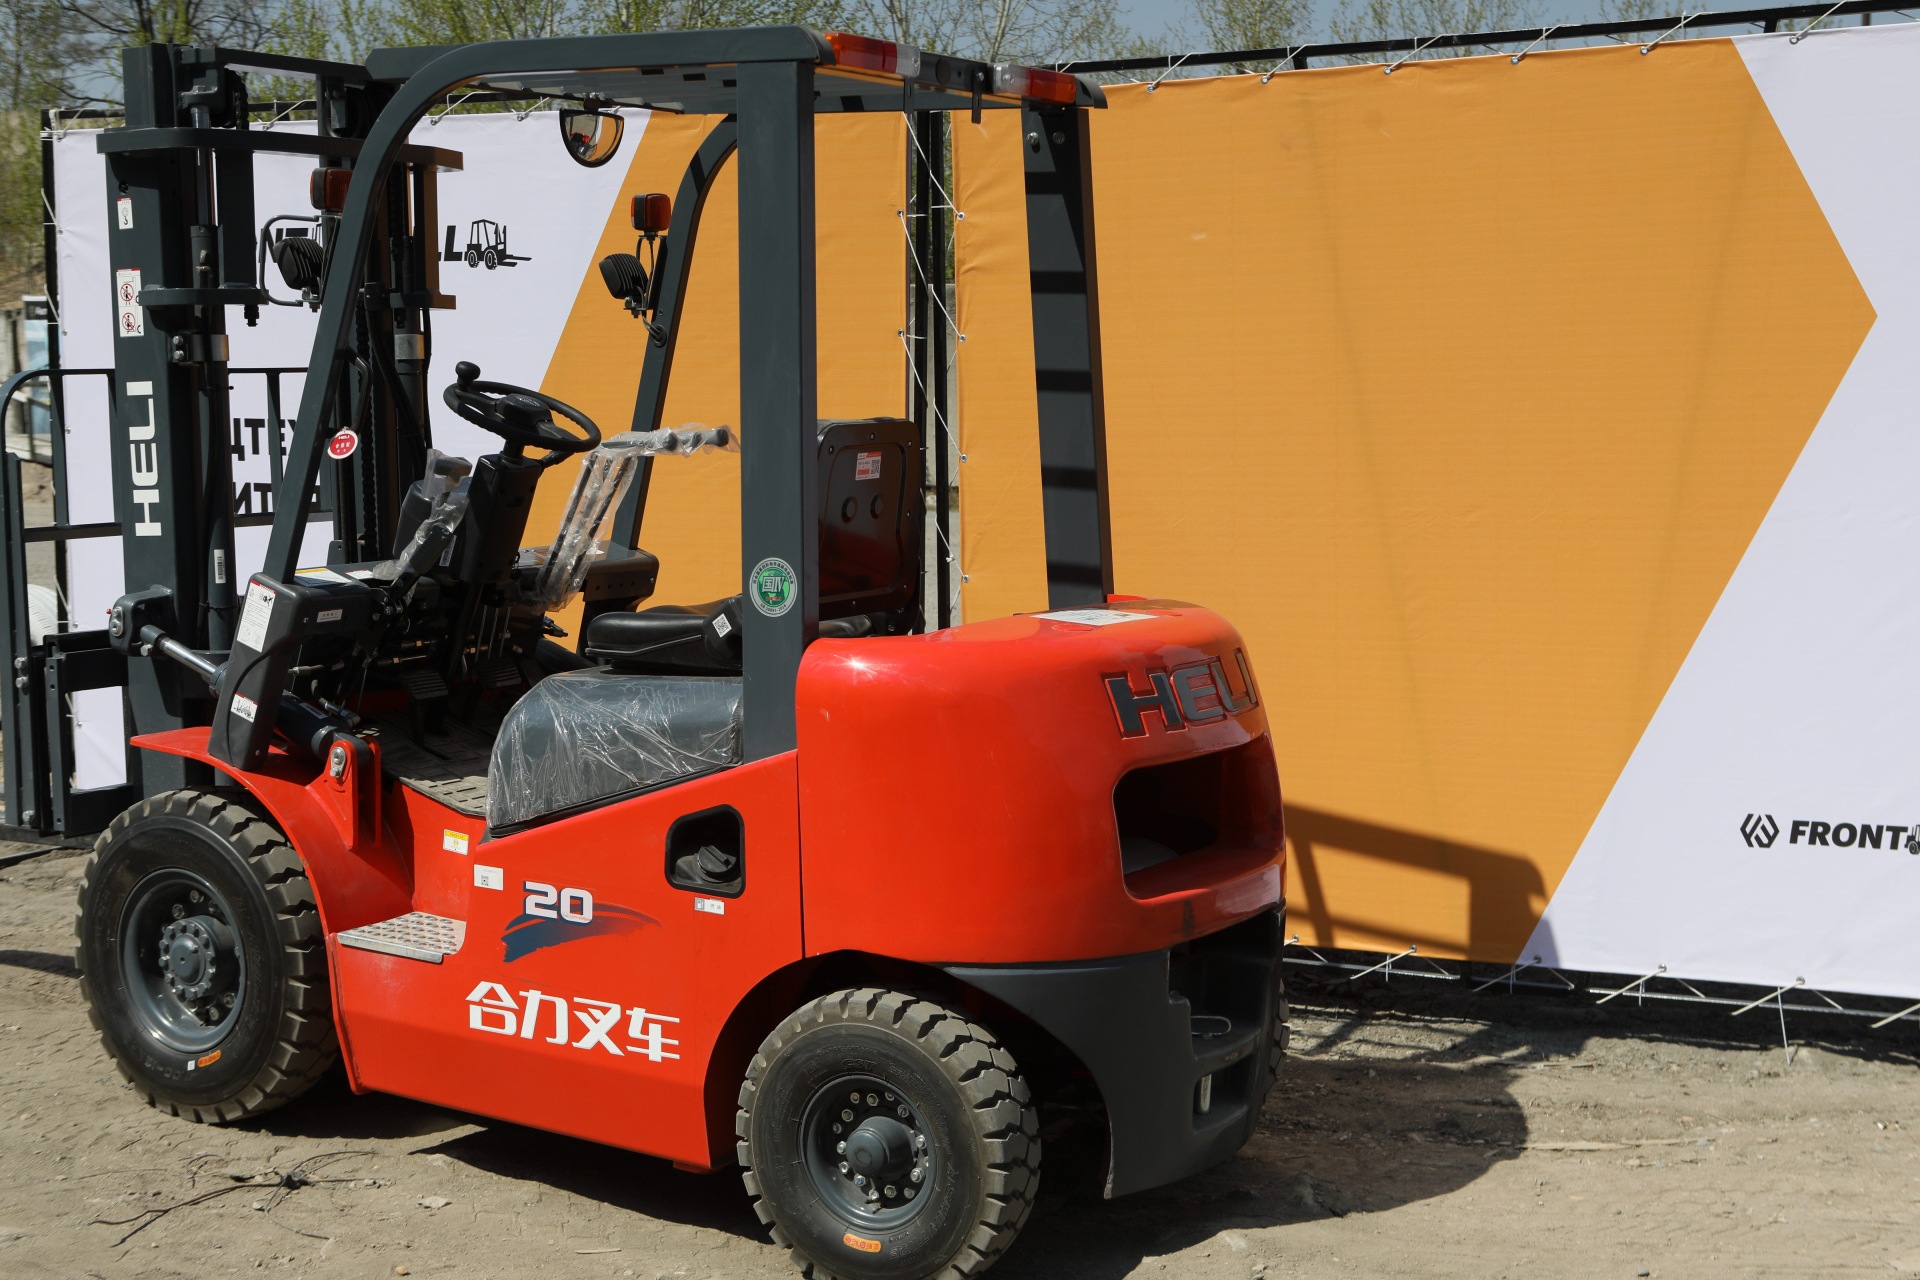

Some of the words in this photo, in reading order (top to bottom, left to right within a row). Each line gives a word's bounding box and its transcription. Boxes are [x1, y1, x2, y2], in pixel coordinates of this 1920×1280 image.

[126, 380, 162, 537] HELI
[1102, 649, 1259, 739] HELI
[1790, 820, 1908, 851] FRONT
[524, 880, 594, 925] 20
[466, 981, 680, 1063] 合力叉车
